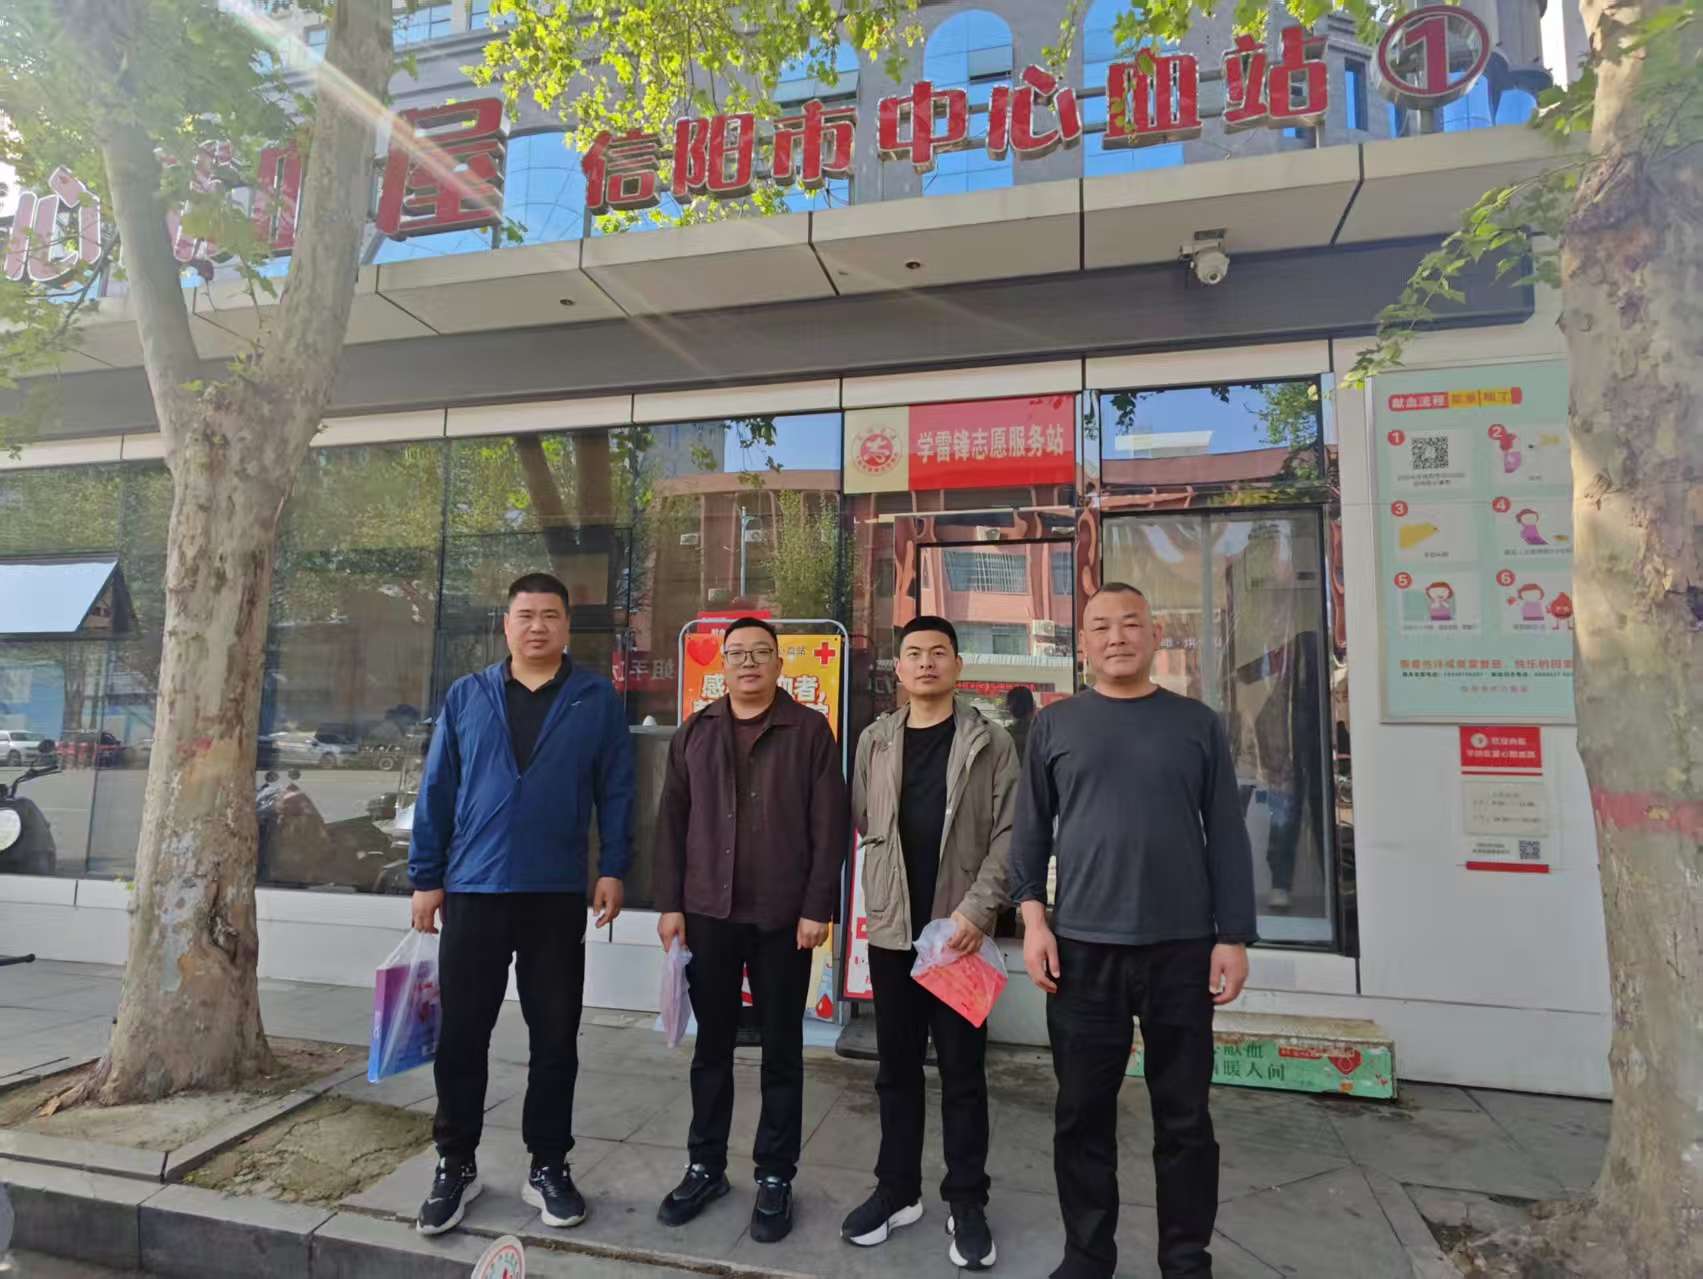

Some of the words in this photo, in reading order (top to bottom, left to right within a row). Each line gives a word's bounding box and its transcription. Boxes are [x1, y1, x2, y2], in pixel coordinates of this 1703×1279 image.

[581, 25, 1328, 209] 信阳市中心血站
[917, 424, 1065, 464] 学雷锋志愿服务站
[1215, 1060, 1285, 1081] 暖人间
